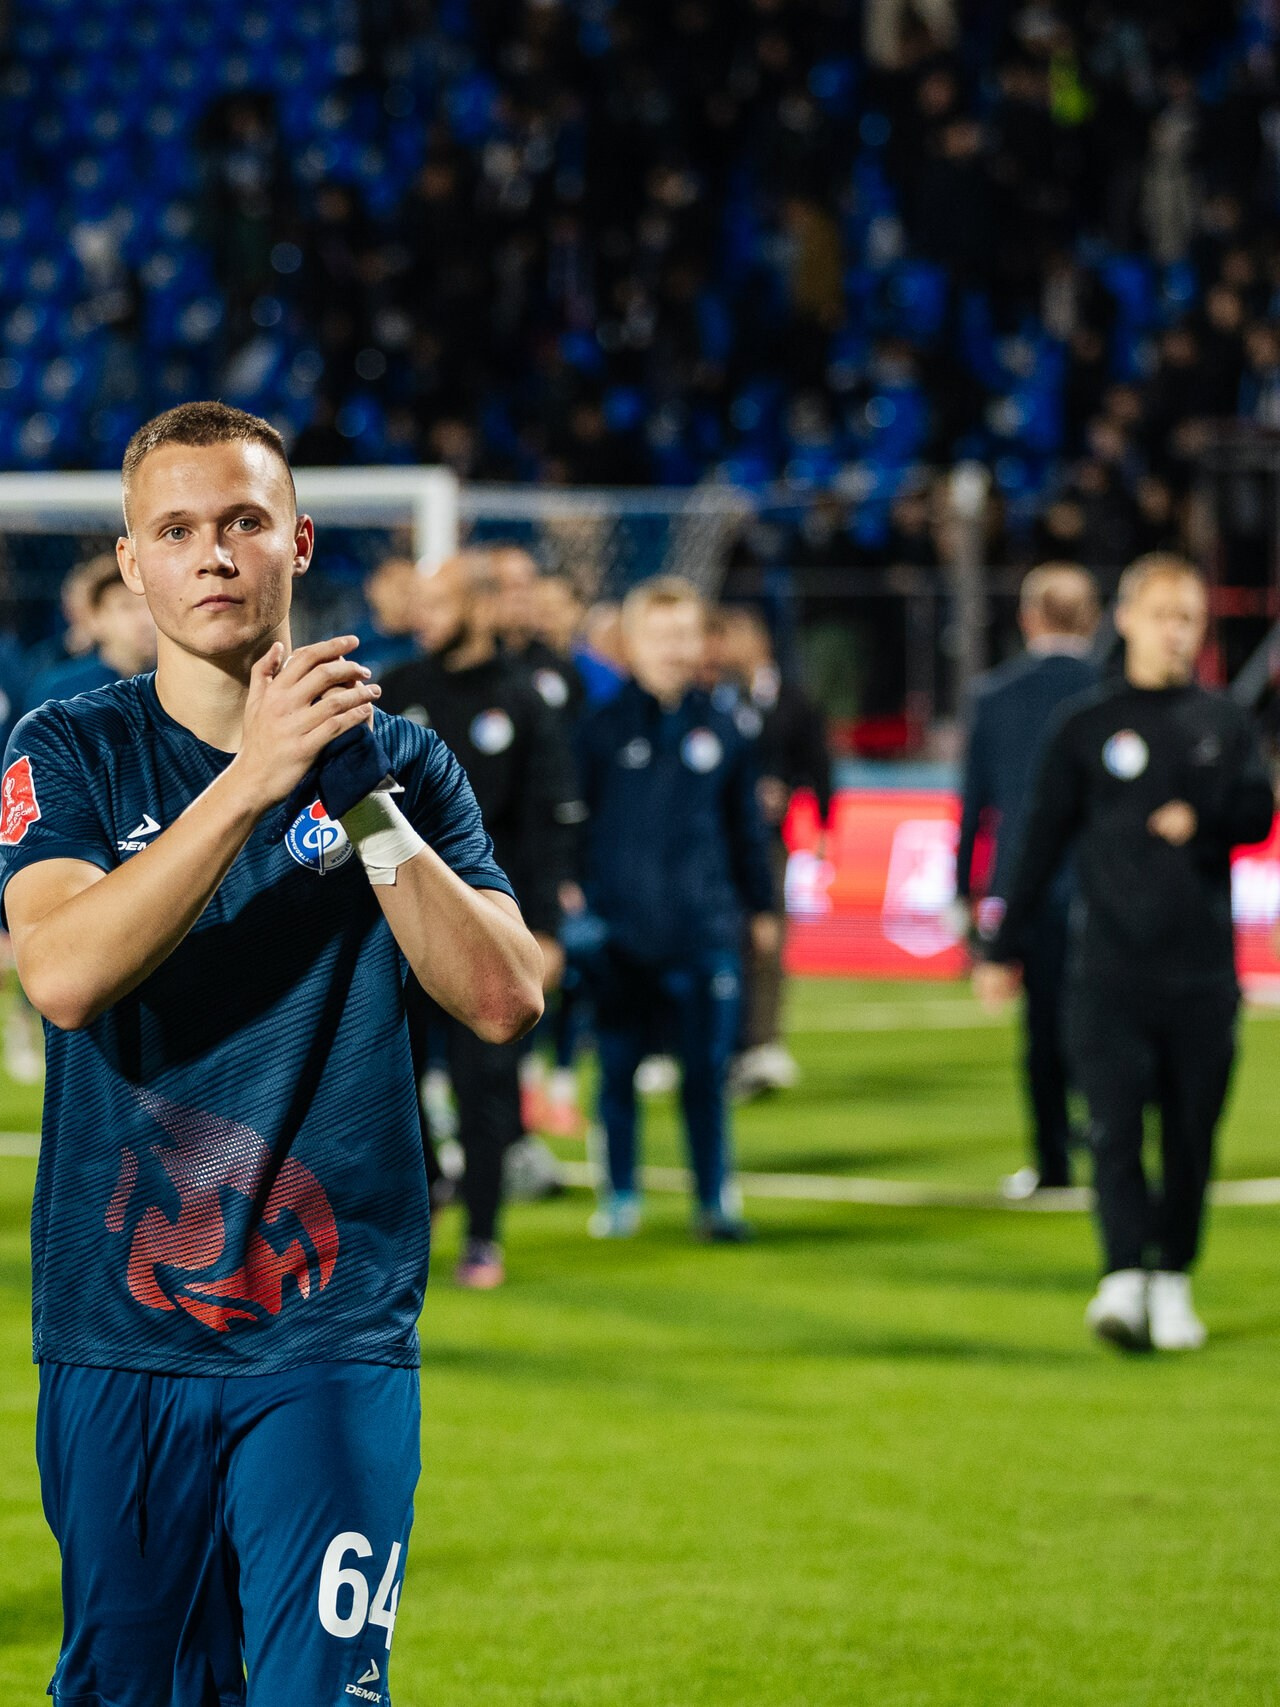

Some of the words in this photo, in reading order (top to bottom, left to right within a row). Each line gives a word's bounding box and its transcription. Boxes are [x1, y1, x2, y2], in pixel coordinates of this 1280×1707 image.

[292, 814, 306, 829] КЛУБ
[318, 1531, 402, 1650] 64
[344, 1683, 382, 1704] DEMIX
